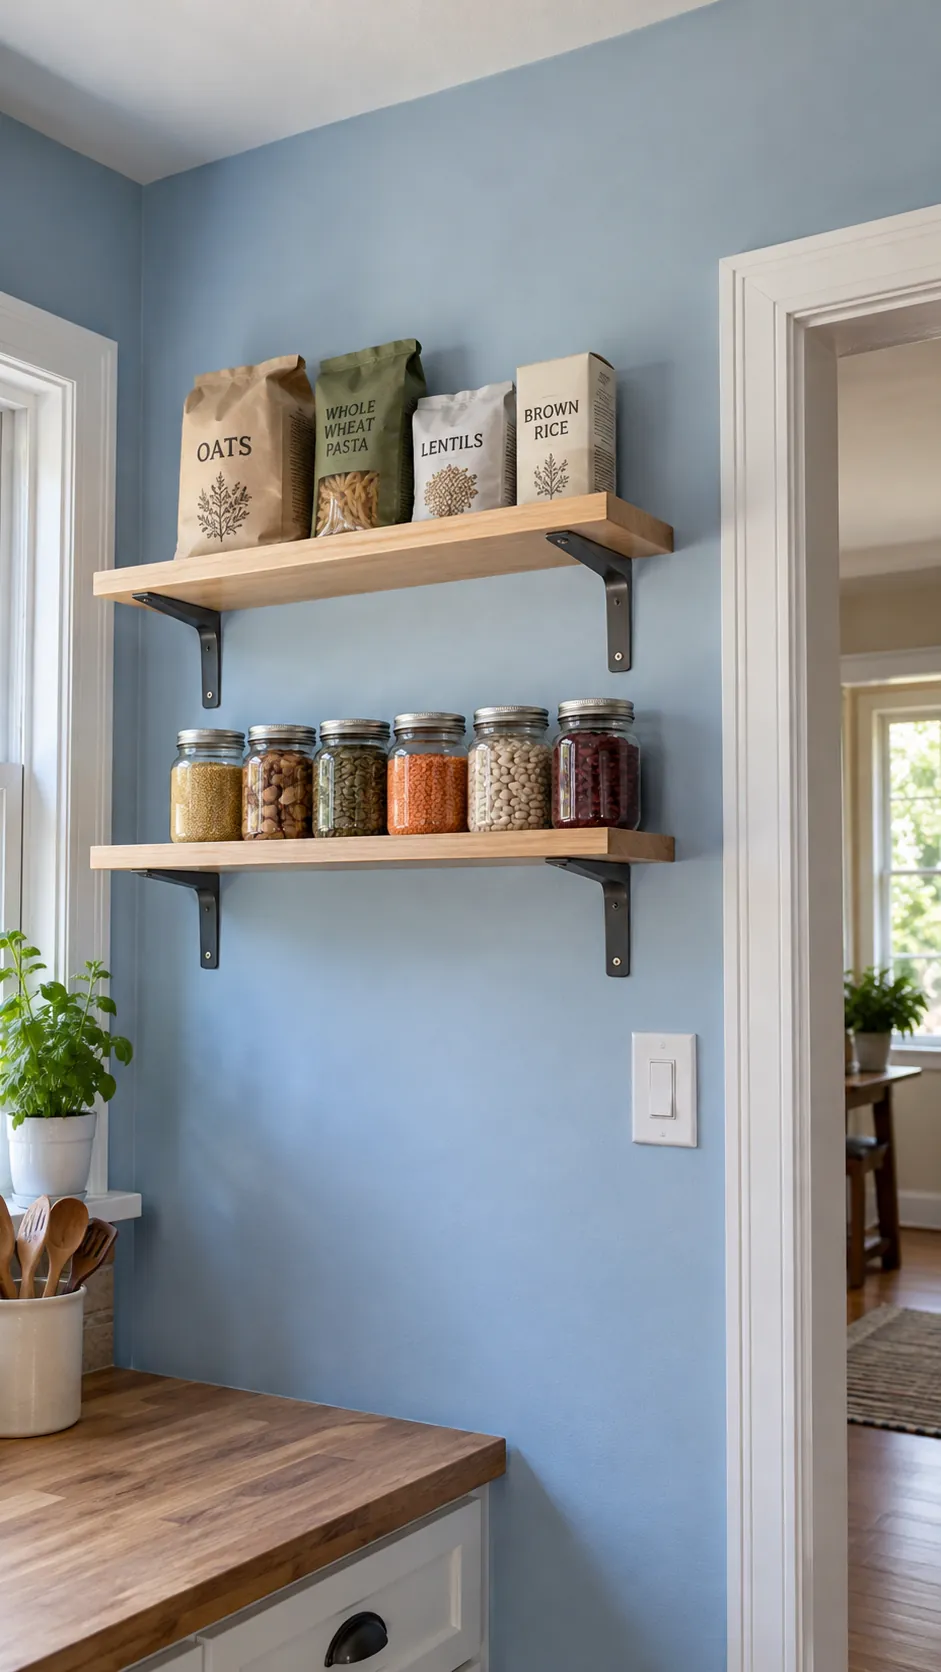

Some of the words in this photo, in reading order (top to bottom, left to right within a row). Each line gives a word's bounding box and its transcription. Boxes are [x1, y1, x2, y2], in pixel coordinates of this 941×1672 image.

[325, 399, 376, 420] WHOLE
[524, 399, 579, 423] BROWN
[324, 417, 376, 439] WHEAT
[534, 420, 569, 440] RICE
[197, 435, 252, 462] OATS
[326, 437, 368, 457] PASTA
[421, 433, 484, 457] LENTILS
